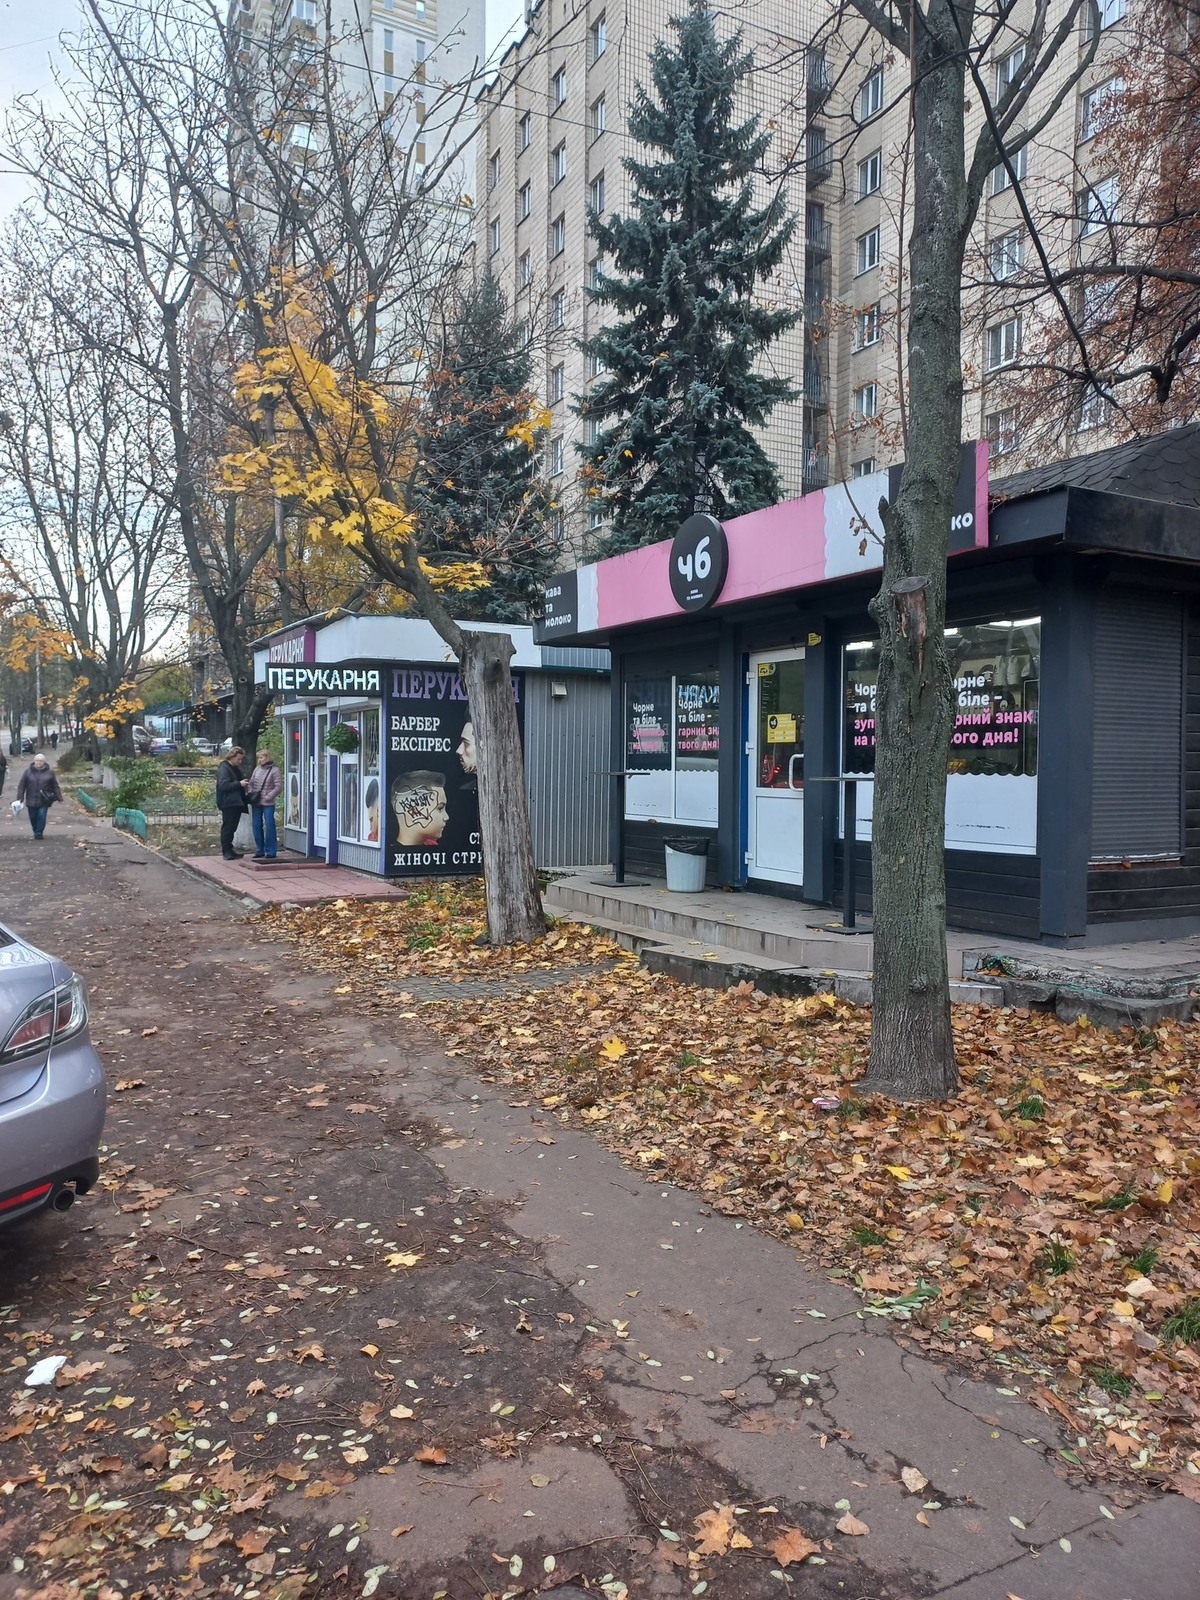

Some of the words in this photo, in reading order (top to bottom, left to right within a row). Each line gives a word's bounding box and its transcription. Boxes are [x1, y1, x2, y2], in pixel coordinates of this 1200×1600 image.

[545, 586, 562, 599] кава
[545, 603, 553, 613] та
[545, 613, 572, 629] молоко
[270, 635, 305, 663] ПЕРУКАРНЯ
[268, 667, 380, 691] ПЕРУКАРНЯ
[953, 675, 986, 692] рне
[854, 683, 877, 698] Чор
[678, 699, 703, 712] Чорне
[958, 690, 990, 707] біле
[632, 702, 655, 714] Чорне
[854, 702, 867, 713] та
[391, 715, 440, 732] БАРБЕР
[632, 717, 640, 725] та
[641, 713, 657, 725] біле
[678, 714, 687, 723] та
[688, 710, 706, 723] біле
[953, 707, 991, 729] рний
[995, 711, 1033, 724] знак
[678, 723, 706, 738] гарний
[951, 732, 979, 744] ого
[982, 727, 1019, 746] дня!
[391, 736, 451, 752] ЕКСПРЕС
[677, 741, 699, 750] твого
[854, 735, 868, 746] на
[393, 852, 446, 866] ЖІНОЧІ
[452, 851, 483, 864] СТР
